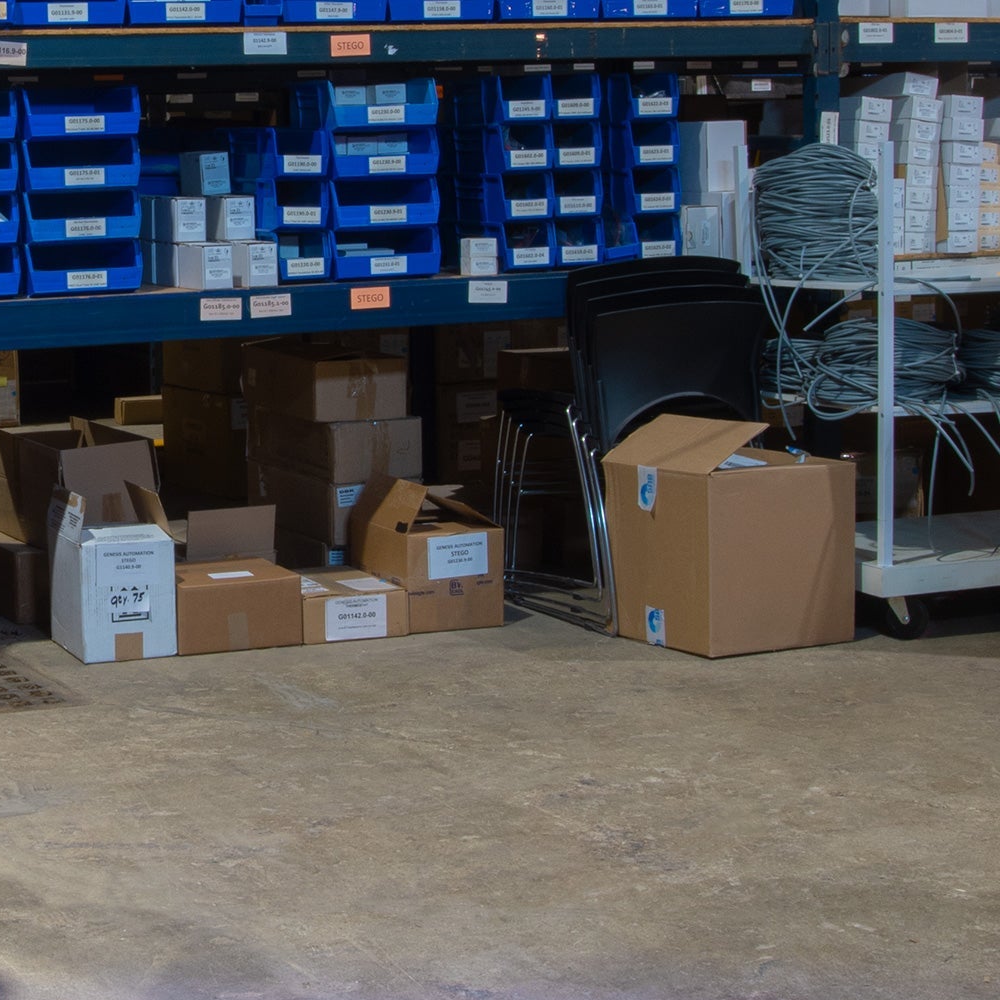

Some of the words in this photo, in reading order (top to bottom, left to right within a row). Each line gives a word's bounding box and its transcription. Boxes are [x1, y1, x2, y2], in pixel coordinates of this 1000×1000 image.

[336, 41, 364, 50] STEGO
[357, 293, 384, 304] STEGO
[203, 302, 239, 310] G01185.0-00
[450, 549, 469, 558] STEGO
[132, 592, 145, 604] 75
[338, 611, 377, 621] G01142.0-00
